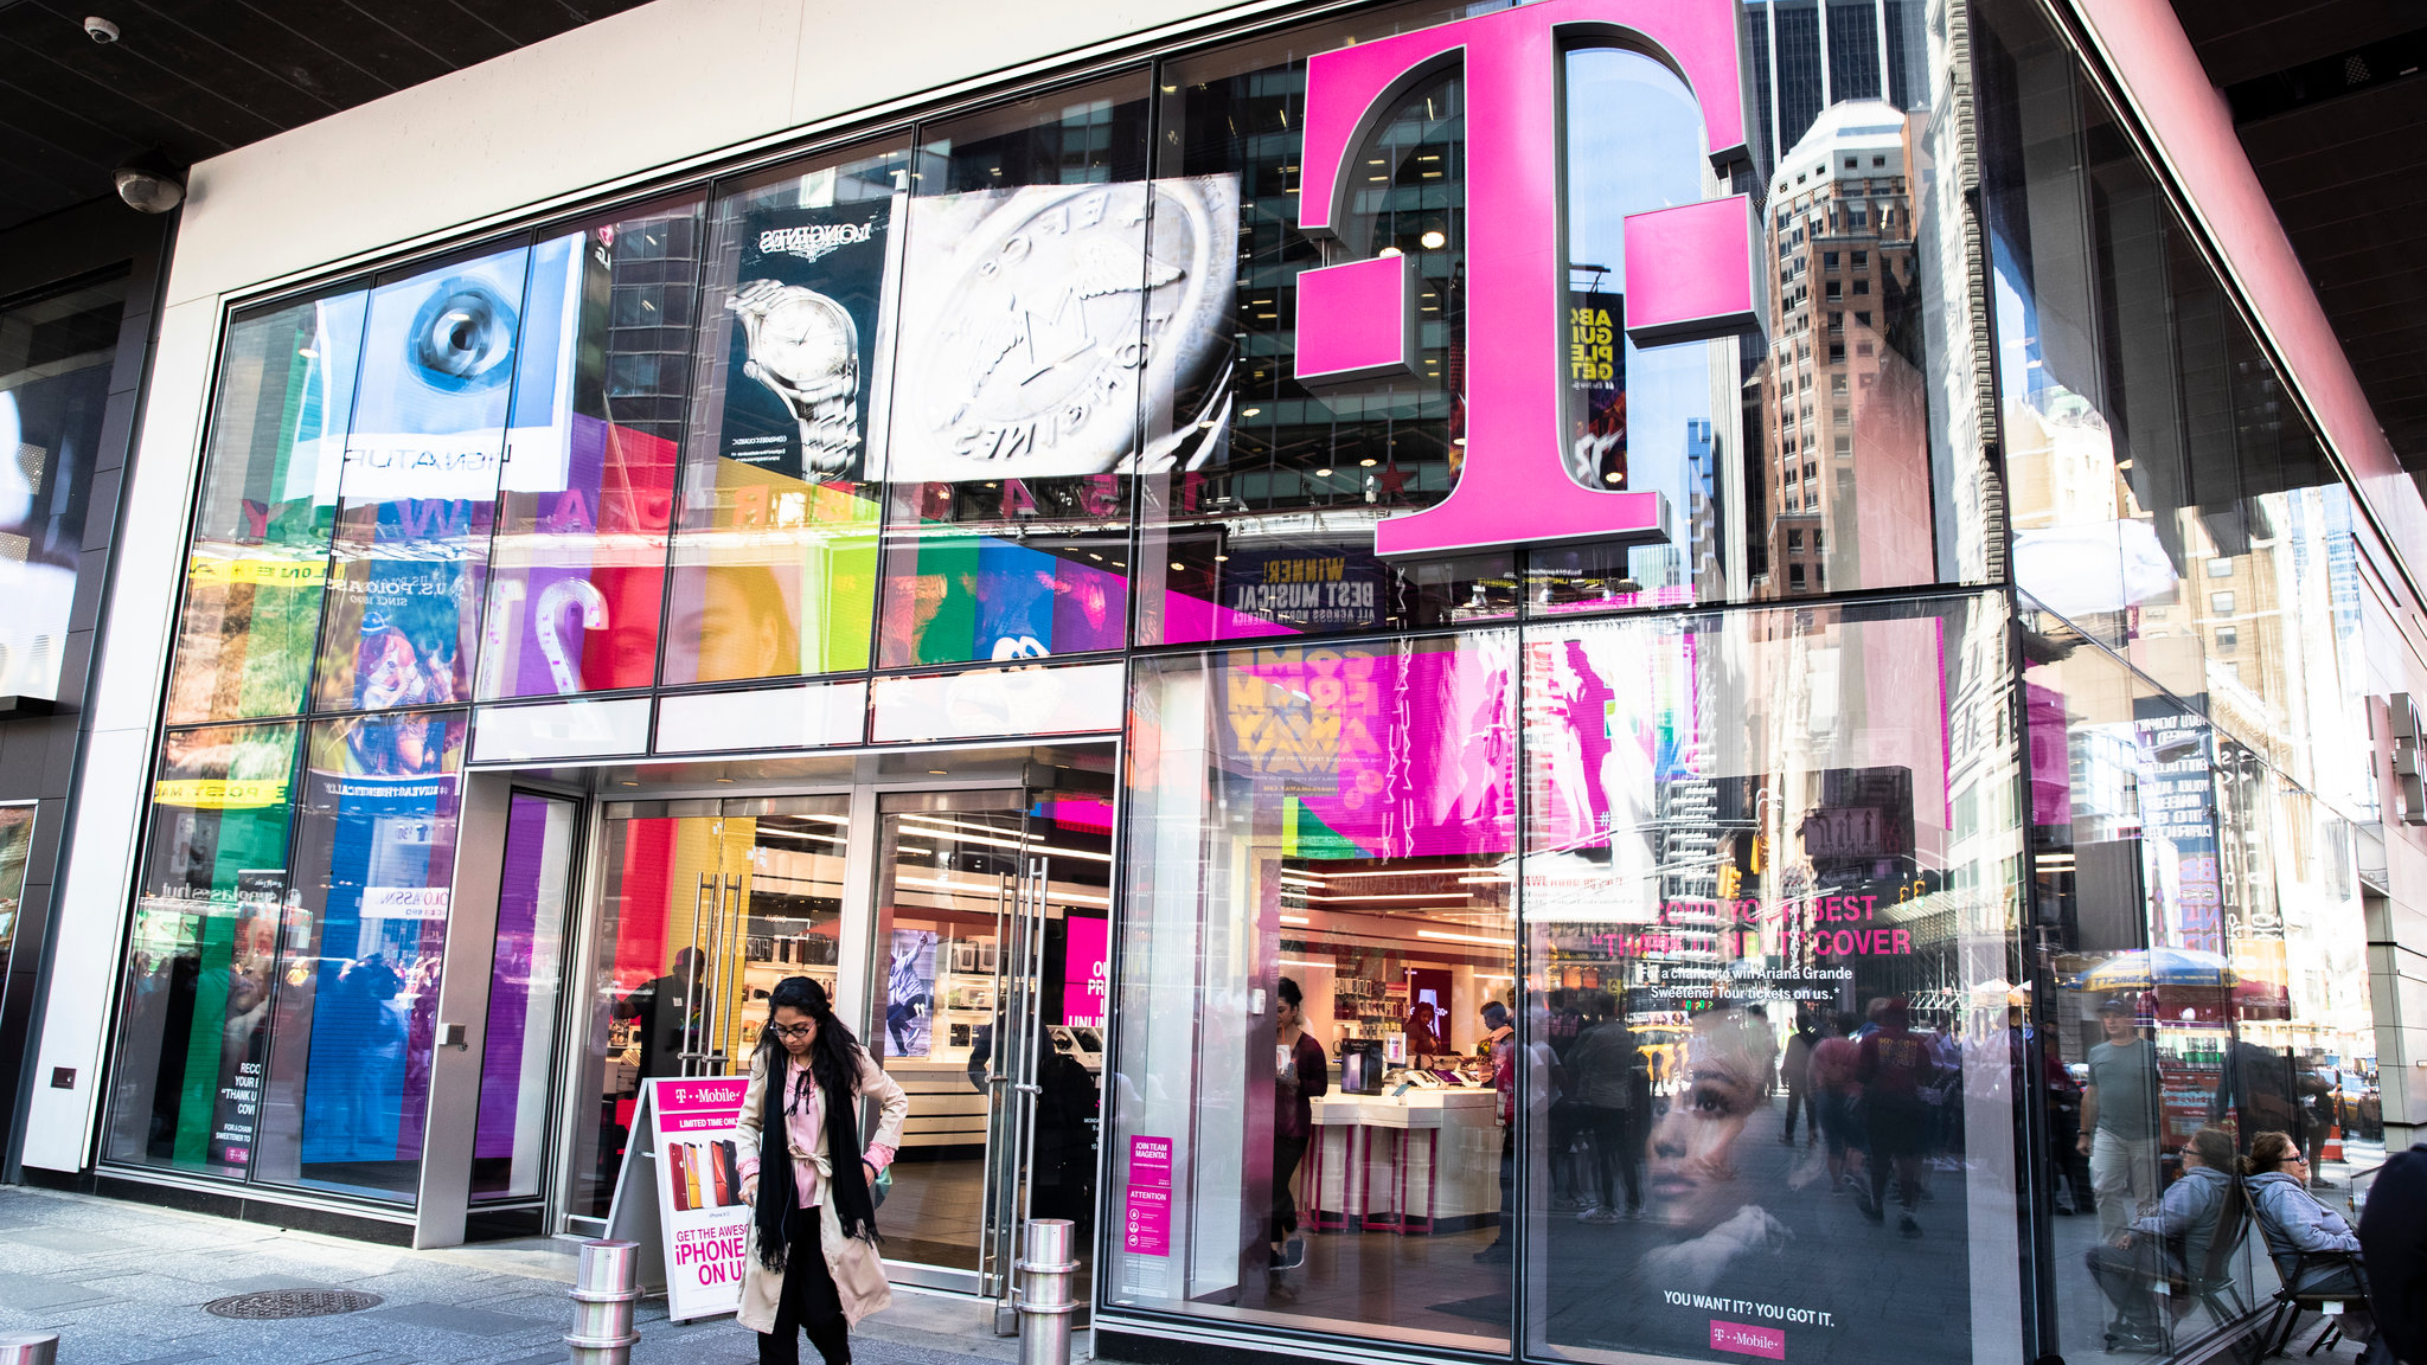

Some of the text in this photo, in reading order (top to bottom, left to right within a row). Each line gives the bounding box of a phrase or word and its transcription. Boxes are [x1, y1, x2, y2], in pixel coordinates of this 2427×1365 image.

[1728, 899, 1801, 922] YOR
[1812, 895, 1878, 922] BEST
[1813, 928, 1912, 956] COVER
[1641, 966, 1659, 980] For
[1661, 970, 1670, 980] a
[1671, 966, 1717, 980] chance
[1732, 967, 1756, 981] win
[1757, 966, 1801, 981] Ariana
[1803, 966, 1853, 981] Grande
[1650, 987, 1716, 1001] Sweetener
[1718, 987, 1746, 1001] Tour
[1748, 987, 1791, 1001] tickets
[1794, 990, 1810, 1001] on
[235, 1076, 255, 1087] YOUR
[251, 1091, 257, 1101] U
[224, 1123, 236, 1131] FOR
[679, 1118, 706, 1129] LIMITED
[707, 1117, 723, 1128] TIME
[215, 1132, 243, 1142] SWEETENER
[1135, 1142, 1167, 1151] JOIN TEAM
[1135, 1150, 1167, 1160] MAGENTA!
[1130, 1190, 1167, 1201] ATTENTION
[676, 1229, 695, 1243] GET
[697, 1227, 716, 1240] THE
[675, 1238, 744, 1266] iPHONE
[698, 1263, 726, 1286] ON
[1664, 1290, 1835, 1327] YOU WANT IT? YOU GOT IT.
